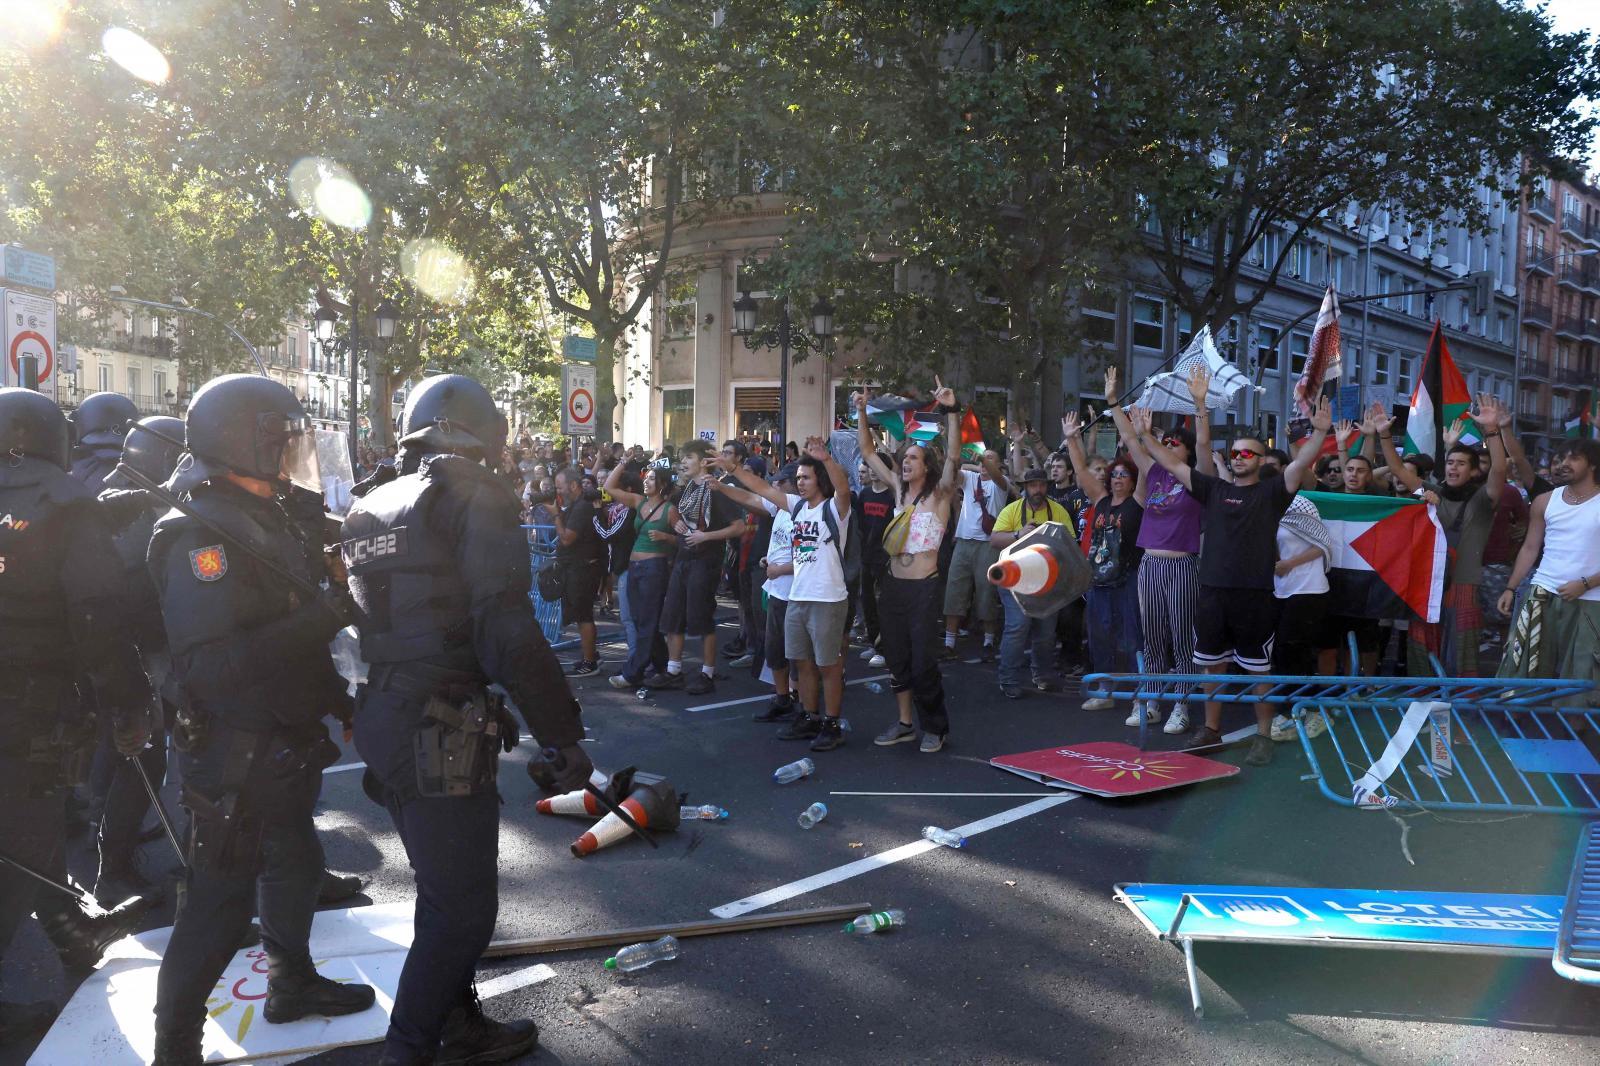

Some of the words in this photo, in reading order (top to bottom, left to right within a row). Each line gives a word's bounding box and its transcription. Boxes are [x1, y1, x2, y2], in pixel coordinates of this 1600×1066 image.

[700, 431, 715, 441] PAZ
[651, 458, 669, 469] PAZ
[349, 533, 397, 562] UC432
[1322, 900, 1563, 919] LOTERÍ
[1374, 916, 1444, 925] CON
